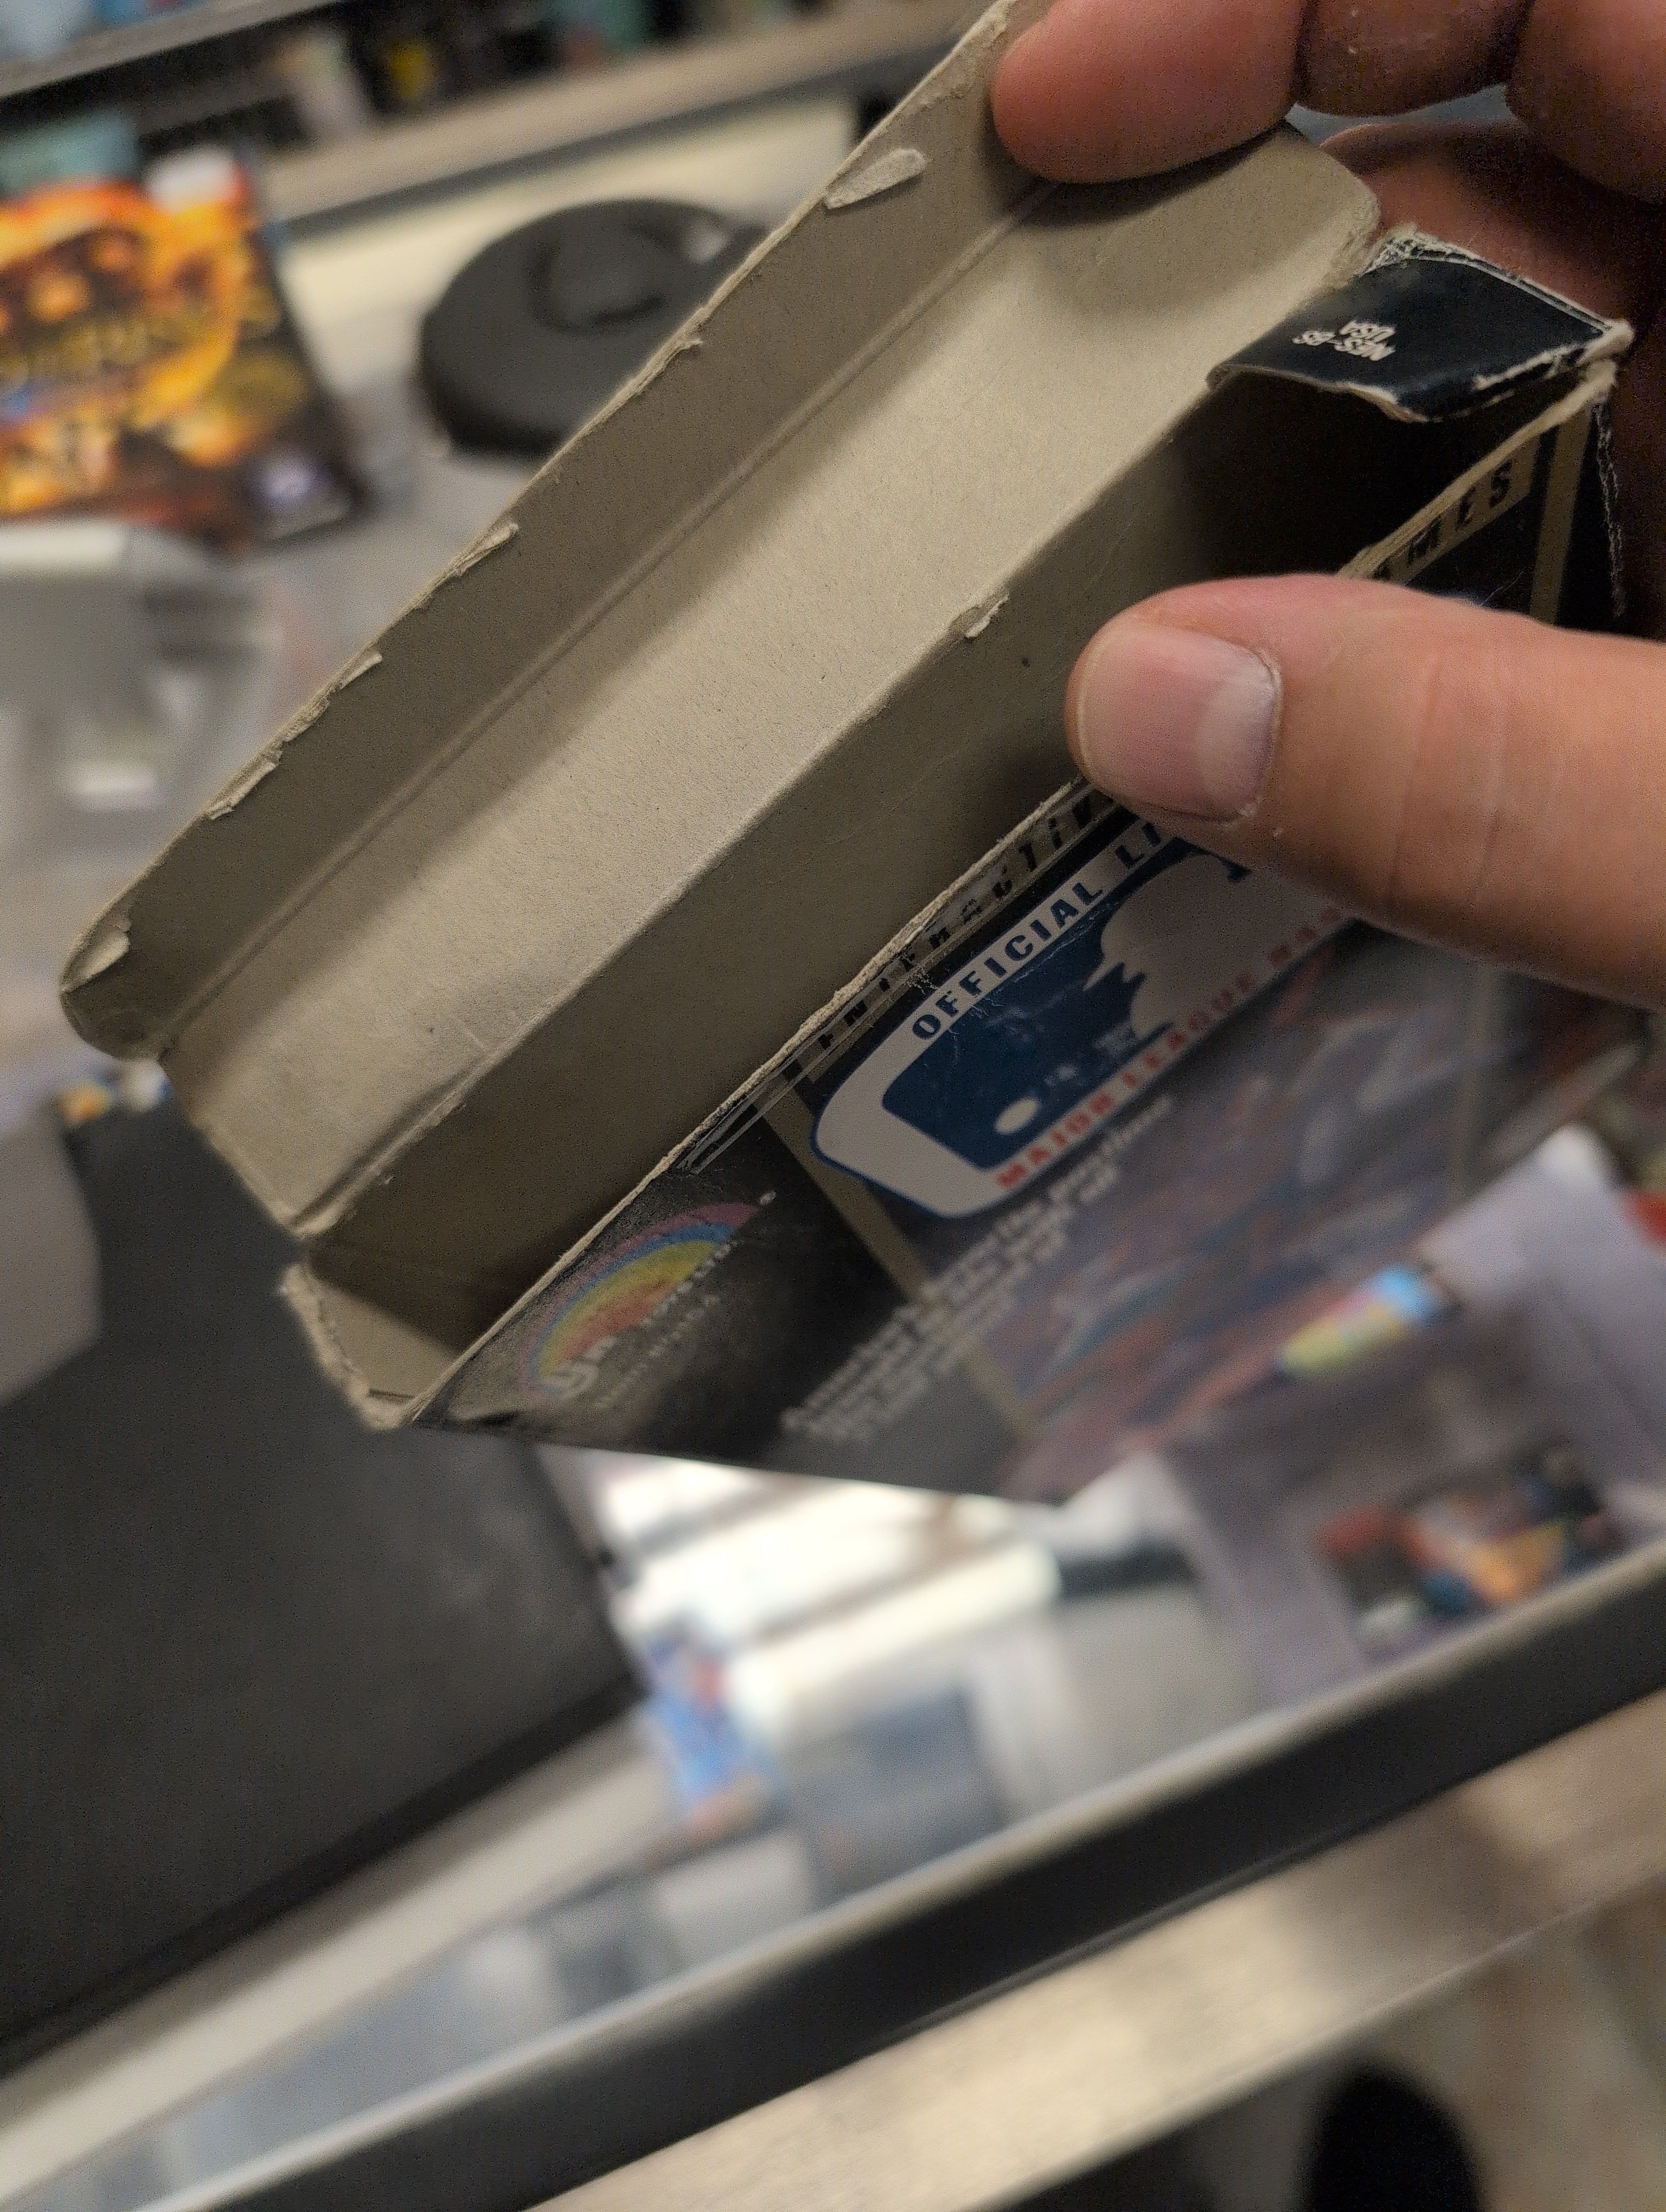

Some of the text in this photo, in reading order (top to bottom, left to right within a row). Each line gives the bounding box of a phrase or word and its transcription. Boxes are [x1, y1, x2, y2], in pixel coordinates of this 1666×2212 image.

[1338, 320, 1395, 342] USA
[911, 882, 1103, 1041] OFFICIAL
[996, 975, 1258, 1190] MAJOR LEAGUE
